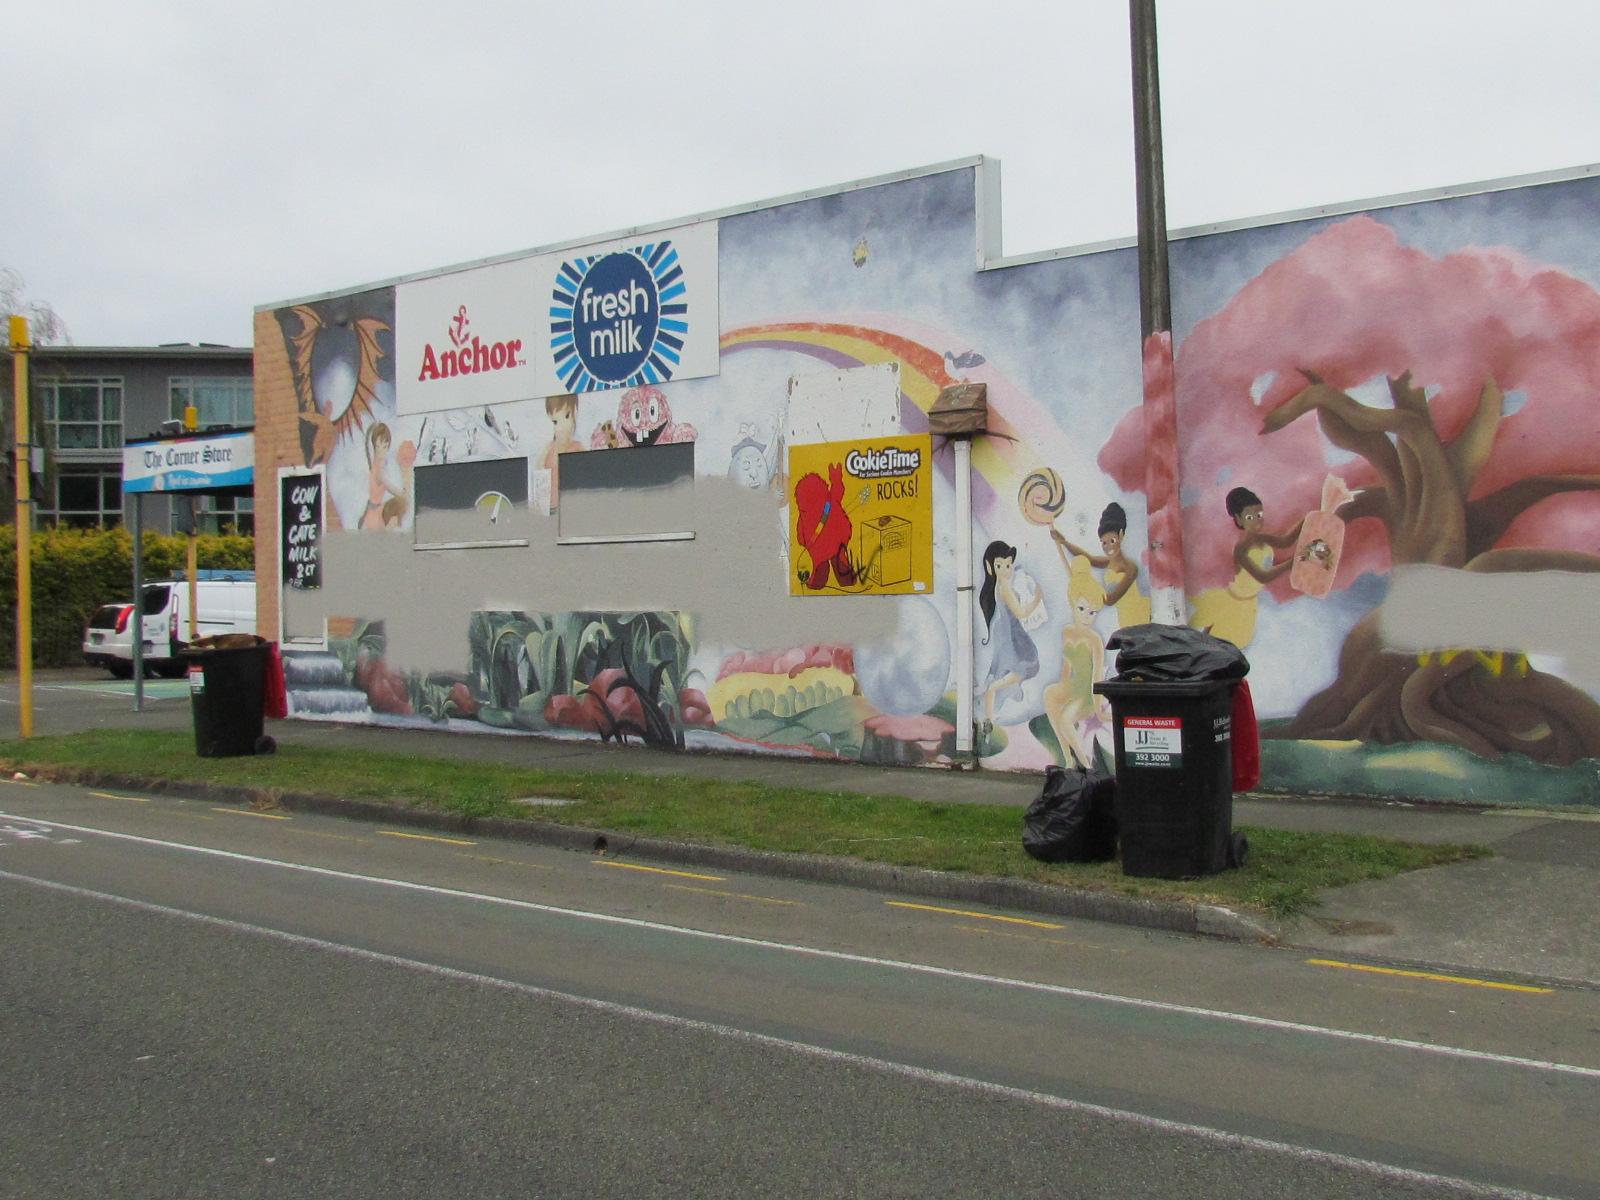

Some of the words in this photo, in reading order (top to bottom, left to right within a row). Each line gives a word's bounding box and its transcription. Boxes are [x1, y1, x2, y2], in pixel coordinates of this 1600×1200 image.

[581, 279, 649, 324] fresh
[590, 319, 643, 358] milk
[418, 335, 522, 382] Anchor
[144, 450, 162, 469] The
[166, 448, 200, 467] Corner
[202, 445, 232, 464] Store
[291, 486, 319, 504] COW
[877, 474, 918, 501] ROCKS!
[299, 505, 312, 522] &
[288, 524, 317, 544] GATE
[288, 545, 317, 562] MILK
[1135, 753, 1149, 761] 392
[1150, 753, 1170, 762] 3000
